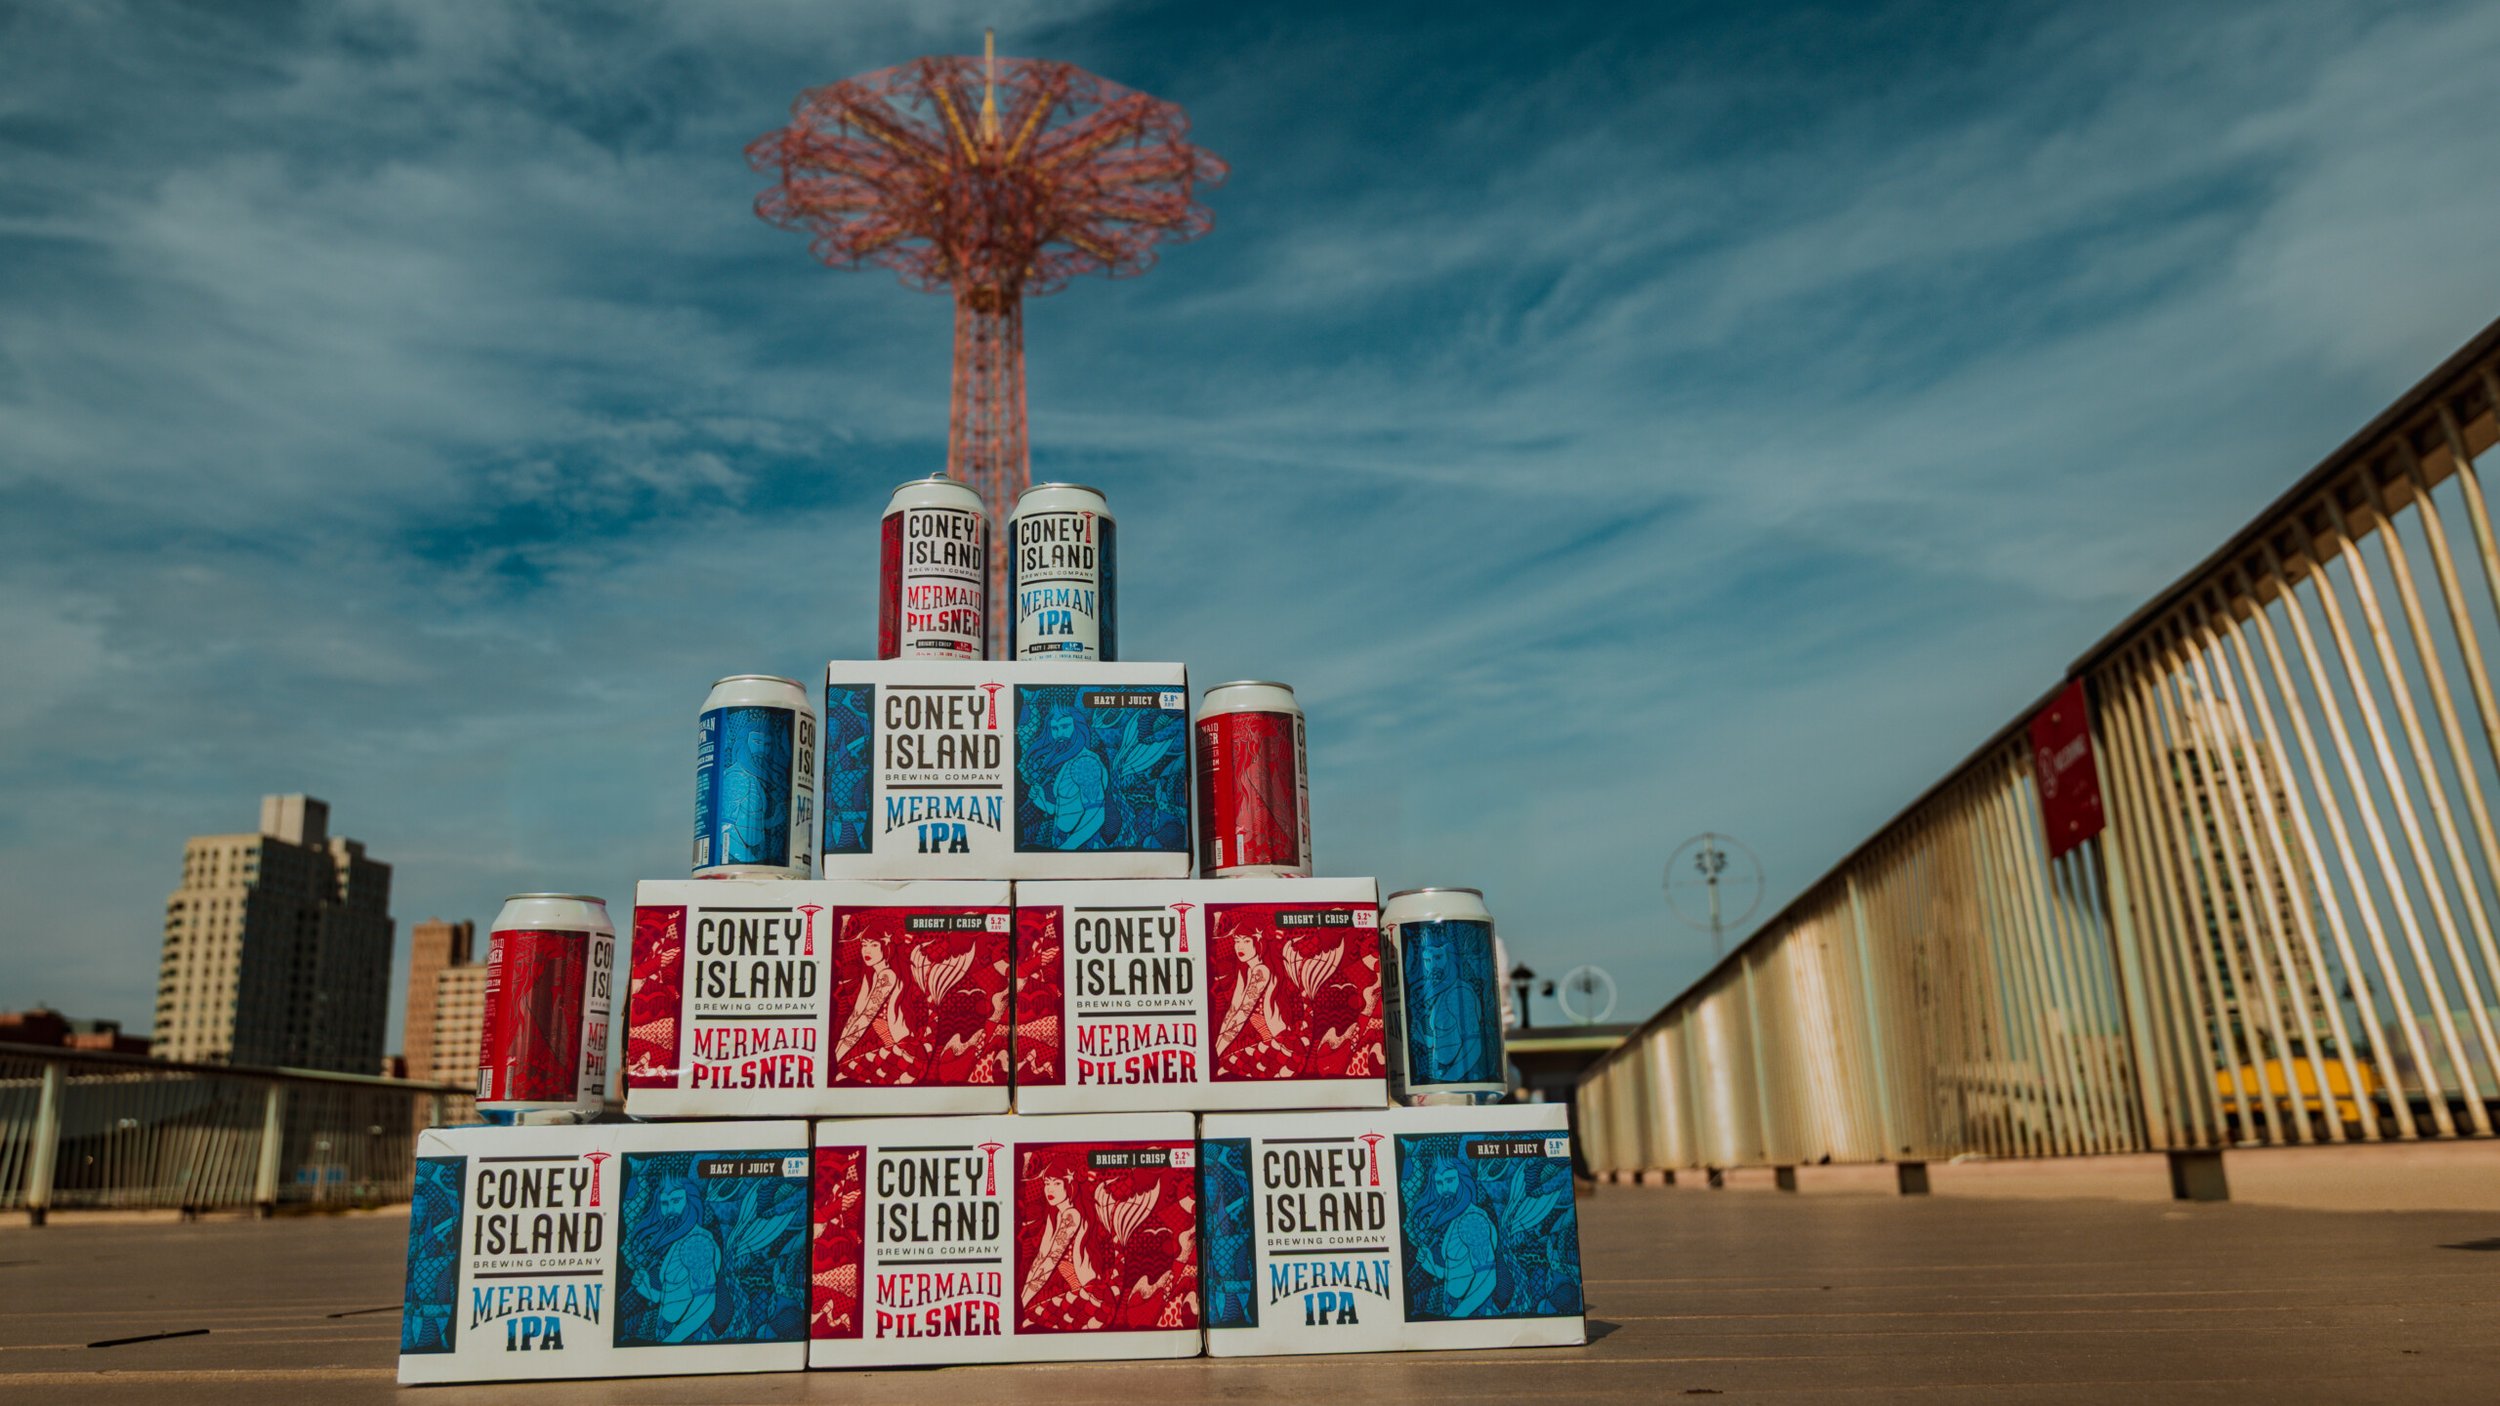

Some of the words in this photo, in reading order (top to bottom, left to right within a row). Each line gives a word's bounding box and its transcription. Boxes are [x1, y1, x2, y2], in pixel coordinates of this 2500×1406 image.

[909, 514, 975, 540] CONEY
[1021, 518, 1084, 545] CONEY
[909, 540, 981, 570] ISLAND
[1021, 545, 1094, 572] ISLAND
[1021, 571, 1053, 580] BREWING
[908, 585, 982, 612] MERMAID
[1020, 588, 1094, 624] MERMAN
[907, 609, 981, 639] PILSNER
[1038, 610, 1074, 636] IPA
[885, 695, 985, 730] CONEY
[1094, 696, 1116, 705] HAZY
[1128, 696, 1152, 705] JUICY
[885, 734, 1000, 770] ISLAND
[885, 796, 1003, 835] MERMAN
[918, 823, 970, 853] IPA
[913, 918, 945, 928] BRIGHT
[957, 918, 982, 928] CRISP
[1075, 917, 1176, 954] CONEY
[1283, 915, 1313, 924] BRIGHT
[1325, 915, 1349, 924] CRISP
[697, 918, 803, 956] CONEY
[695, 960, 817, 998] ISLAND
[1076, 957, 1193, 996] ISLAND
[695, 1003, 751, 1011] BREWING
[1138, 999, 1194, 1007] COMPANY
[693, 1028, 817, 1060] MERMAID
[1077, 1023, 1197, 1057] MERMAID
[691, 1054, 814, 1089] PILSNER
[1077, 1049, 1198, 1085] PILSNER
[1096, 1154, 1129, 1165] BRIGHT
[1140, 1154, 1166, 1164] CRISP
[1478, 1144, 1500, 1155] HAZY
[1513, 1143, 1538, 1154] JUICY
[710, 1163, 734, 1174] HAZY
[747, 1163, 775, 1174] JUICY
[877, 1157, 983, 1198] CONEY
[1263, 1149, 1366, 1189] CONEY
[477, 1167, 589, 1209] CONEY
[877, 1201, 1000, 1243] ISLAND
[1266, 1191, 1385, 1233] ISLAND
[474, 1212, 603, 1255] ISLAND
[1268, 1237, 1323, 1246] BREWING
[1329, 1235, 1387, 1244] COMPANY
[474, 1259, 533, 1269] BREWING
[540, 1258, 601, 1267] COMPANY
[877, 1247, 934, 1256] BREWING
[940, 1246, 999, 1254] COMPANY
[876, 1271, 1001, 1308] MERMAID
[1269, 1260, 1390, 1306] MERMAN
[470, 1283, 603, 1330] MERMAN
[875, 1300, 1001, 1339] PILSNER
[1304, 1291, 1359, 1326] IPA
[506, 1316, 564, 1352] IPA
